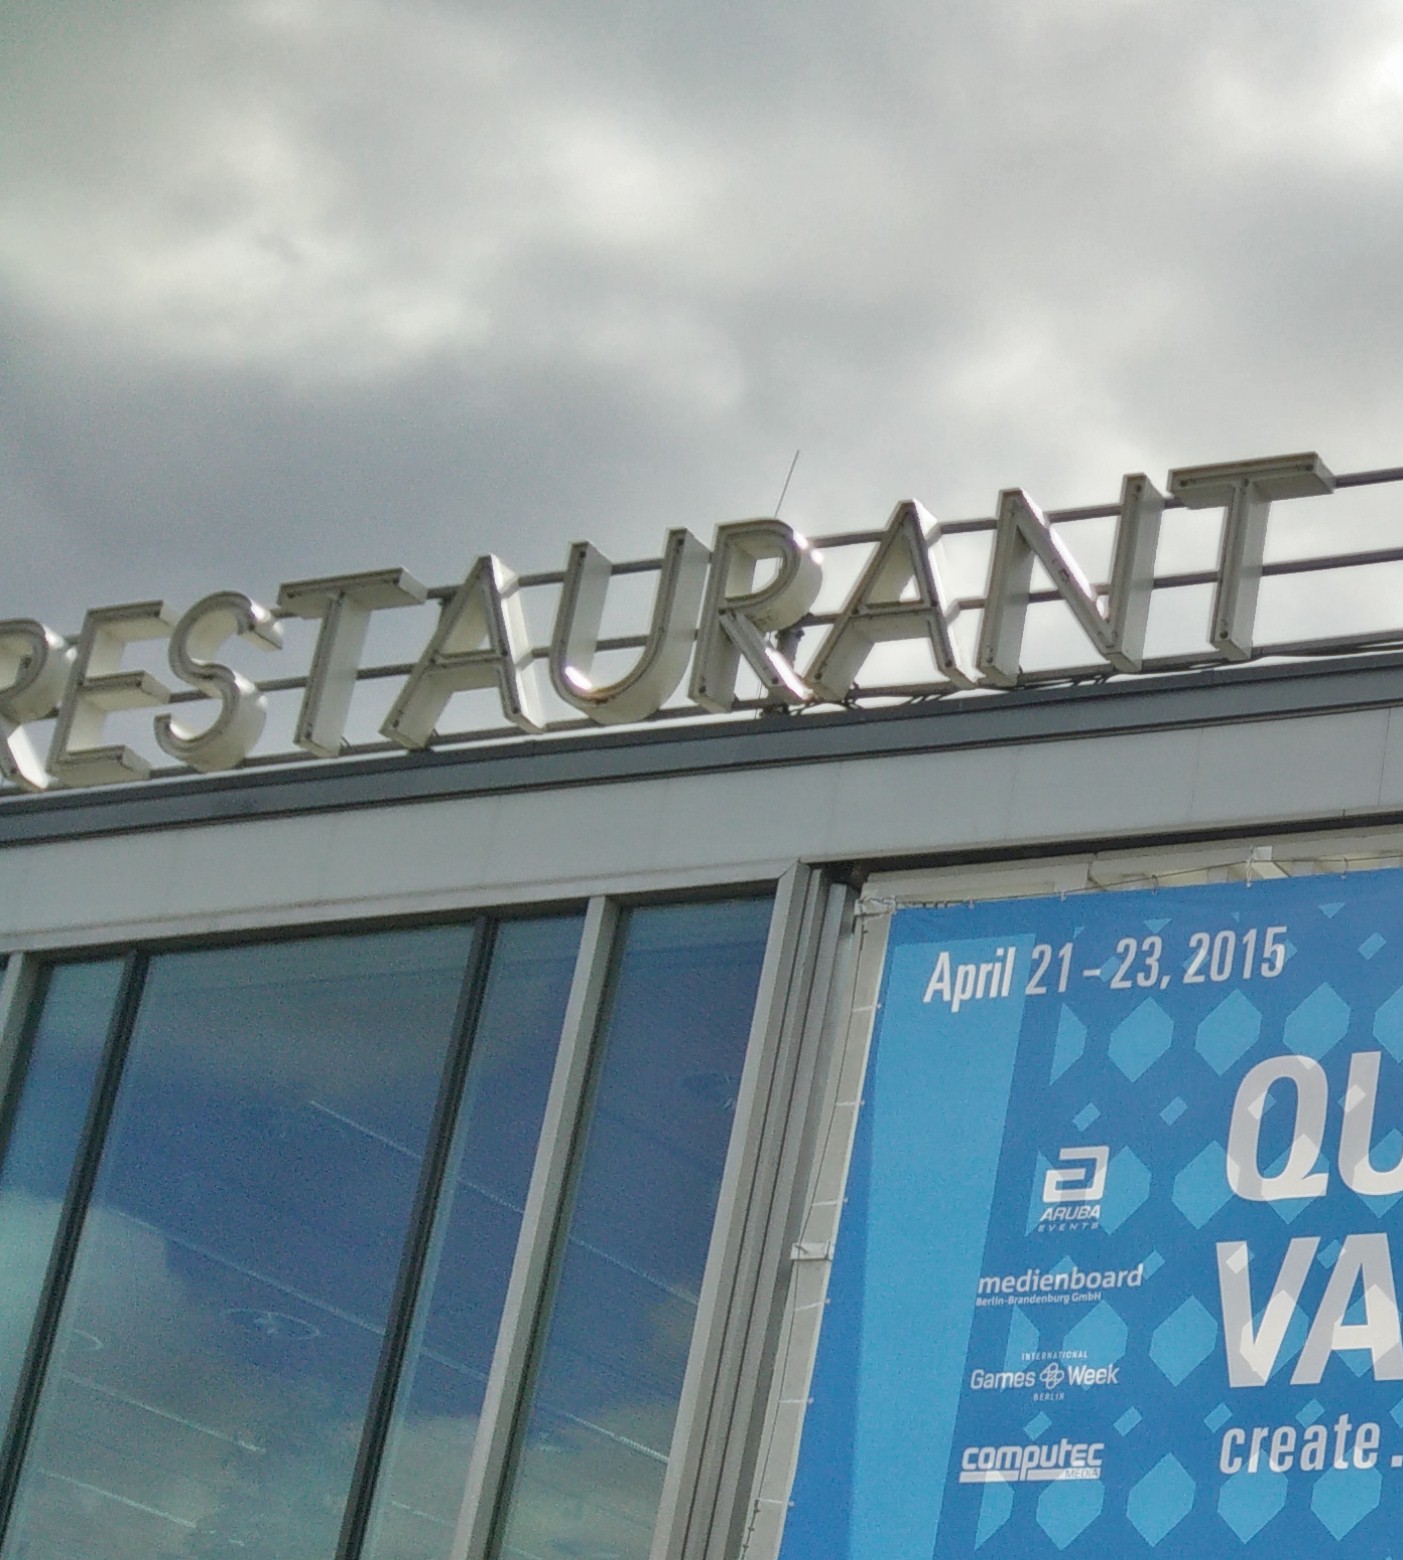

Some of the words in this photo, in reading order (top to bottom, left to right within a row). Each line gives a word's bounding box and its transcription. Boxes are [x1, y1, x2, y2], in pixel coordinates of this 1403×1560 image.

[0, 451, 1336, 790] RESTAURANT
[922, 946, 1017, 1013] April
[1182, 926, 1288, 986] 2015
[1039, 1205, 1101, 1222] ARUBA
[1037, 1222, 1099, 1233] EVENTS
[978, 1264, 1144, 1294] medienboard
[976, 1293, 1070, 1306] Berlin-Brandenburg
[1071, 1291, 1102, 1302] GmbH
[1021, 1350, 1089, 1361] INTERNATIONAL
[970, 1369, 1036, 1390] Games
[1067, 1364, 1121, 1385] Week
[1032, 1392, 1065, 1402] BERLIN
[961, 1438, 1105, 1481] computec
[1064, 1468, 1100, 1479] MEDIA
